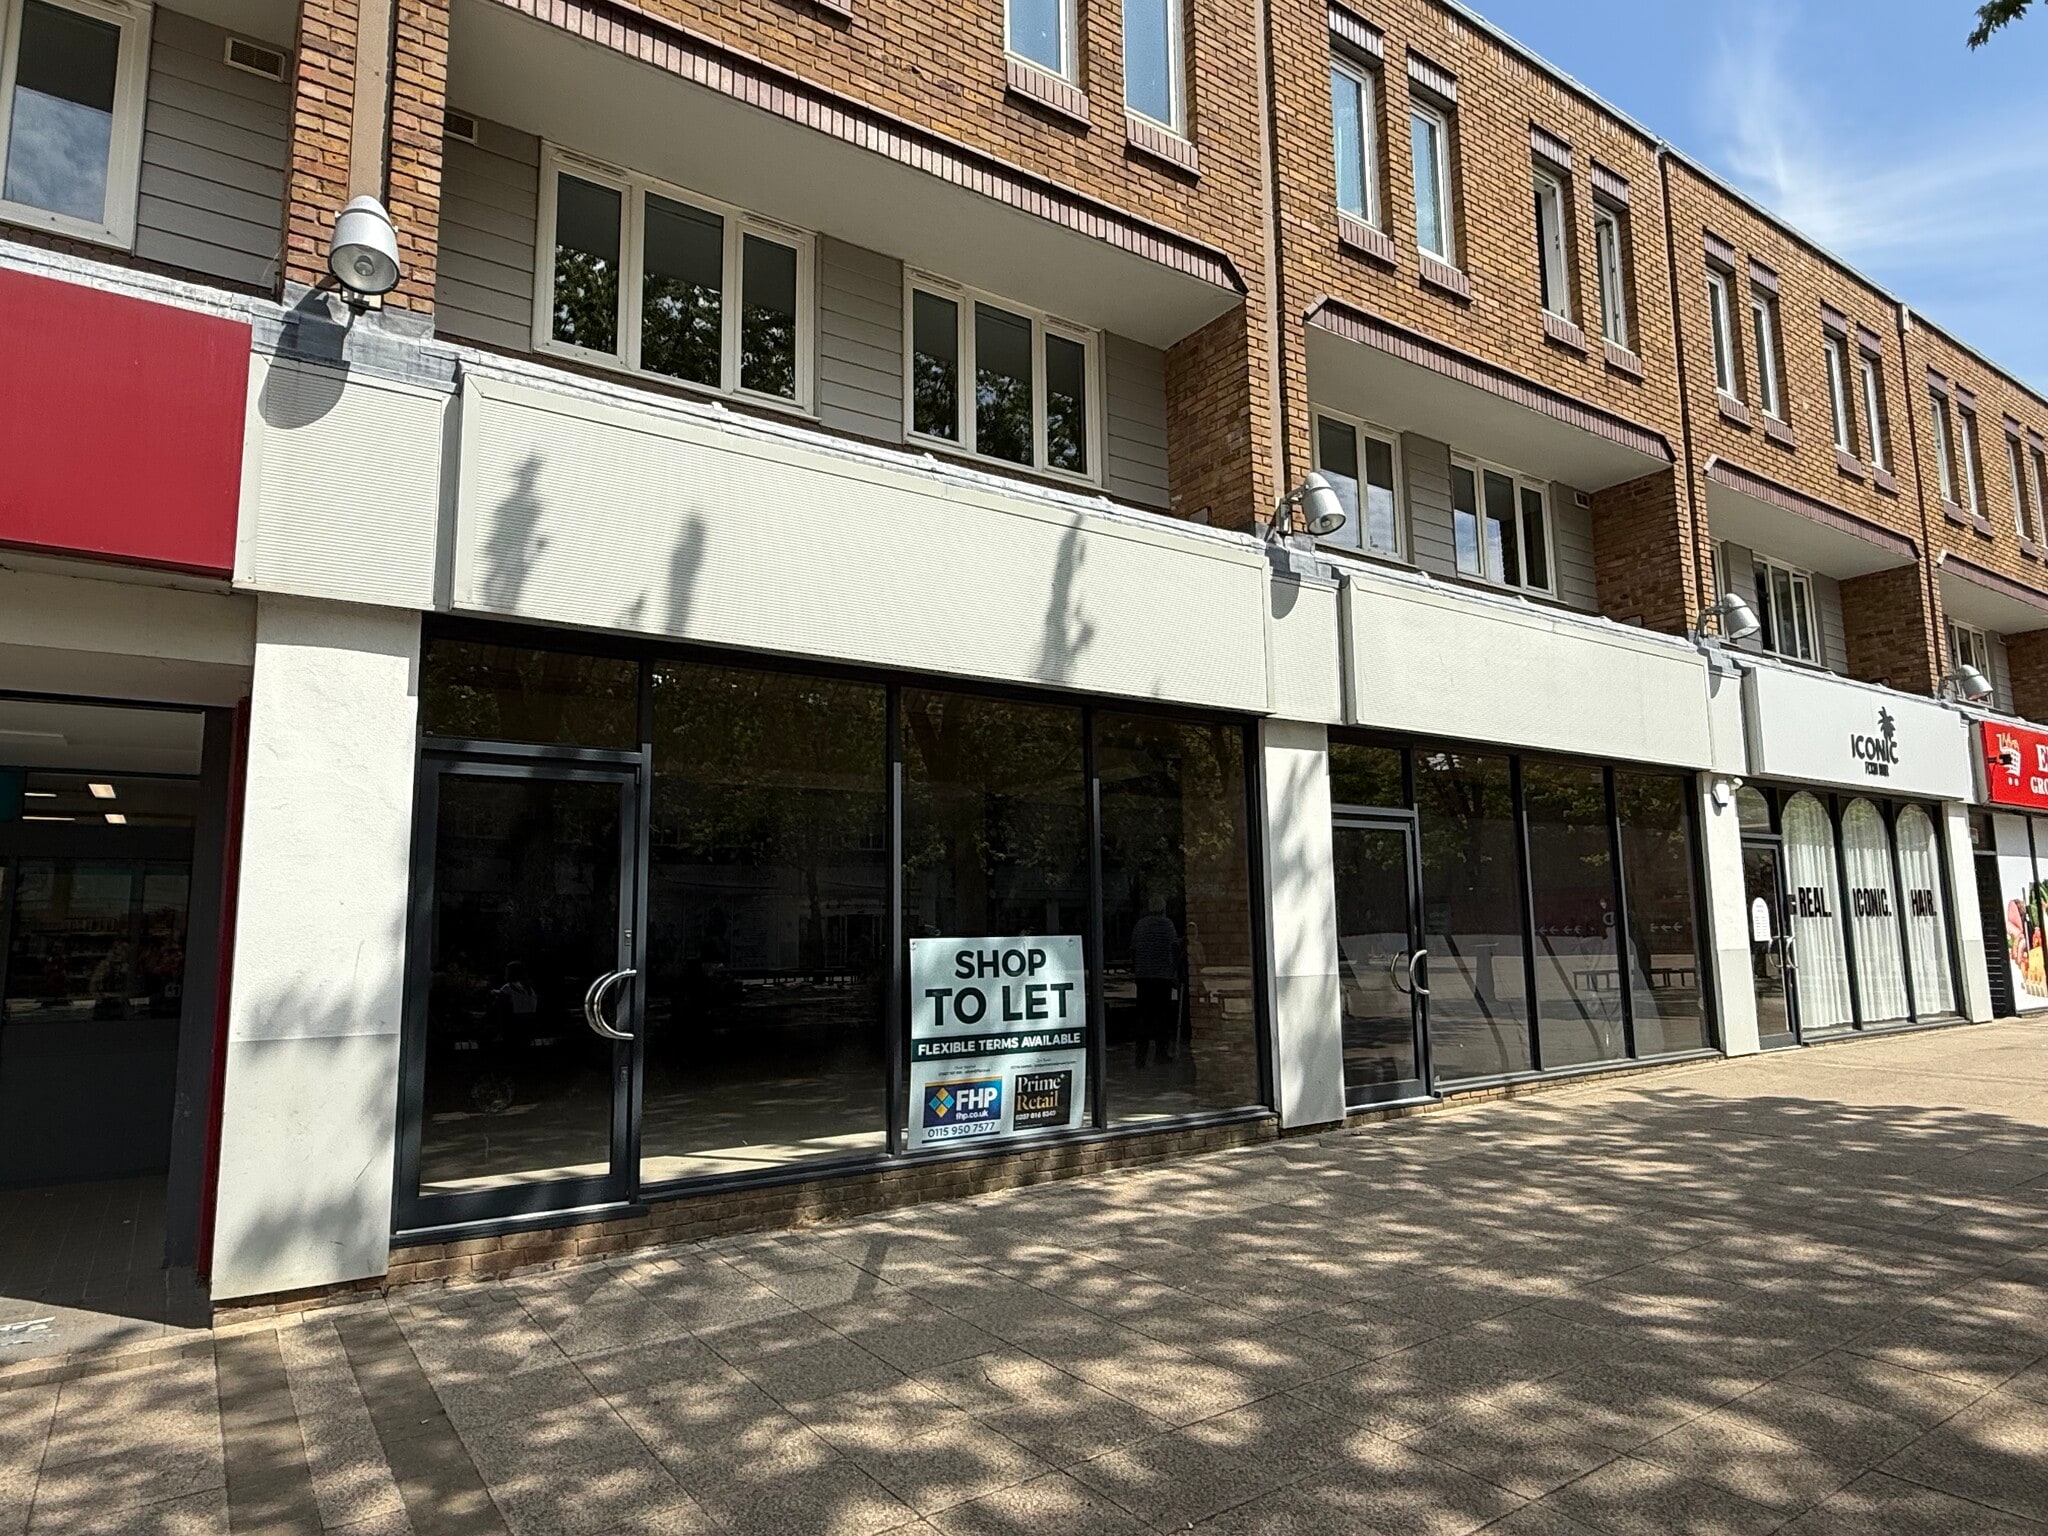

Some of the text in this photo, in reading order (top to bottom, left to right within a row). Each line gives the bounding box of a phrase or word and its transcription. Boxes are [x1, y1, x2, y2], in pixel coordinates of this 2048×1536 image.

[1851, 734, 1899, 764] ICONIC
[2035, 743, 2048, 773] E
[1798, 887, 1937, 918] REAL. ICONIC. HAIR.
[955, 949, 1046, 979] SHOP
[925, 983, 1073, 1026] TO LET
[918, 1032, 1081, 1056] FLEXIBLE TERMS AVAILABLE
[1017, 1075, 1061, 1093] Prime
[956, 1087, 998, 1111] FHP
[1017, 1090, 1058, 1111] Retail
[956, 1109, 988, 1120] fhp.co.uk
[928, 1122, 995, 1138] 0115 950 7577
